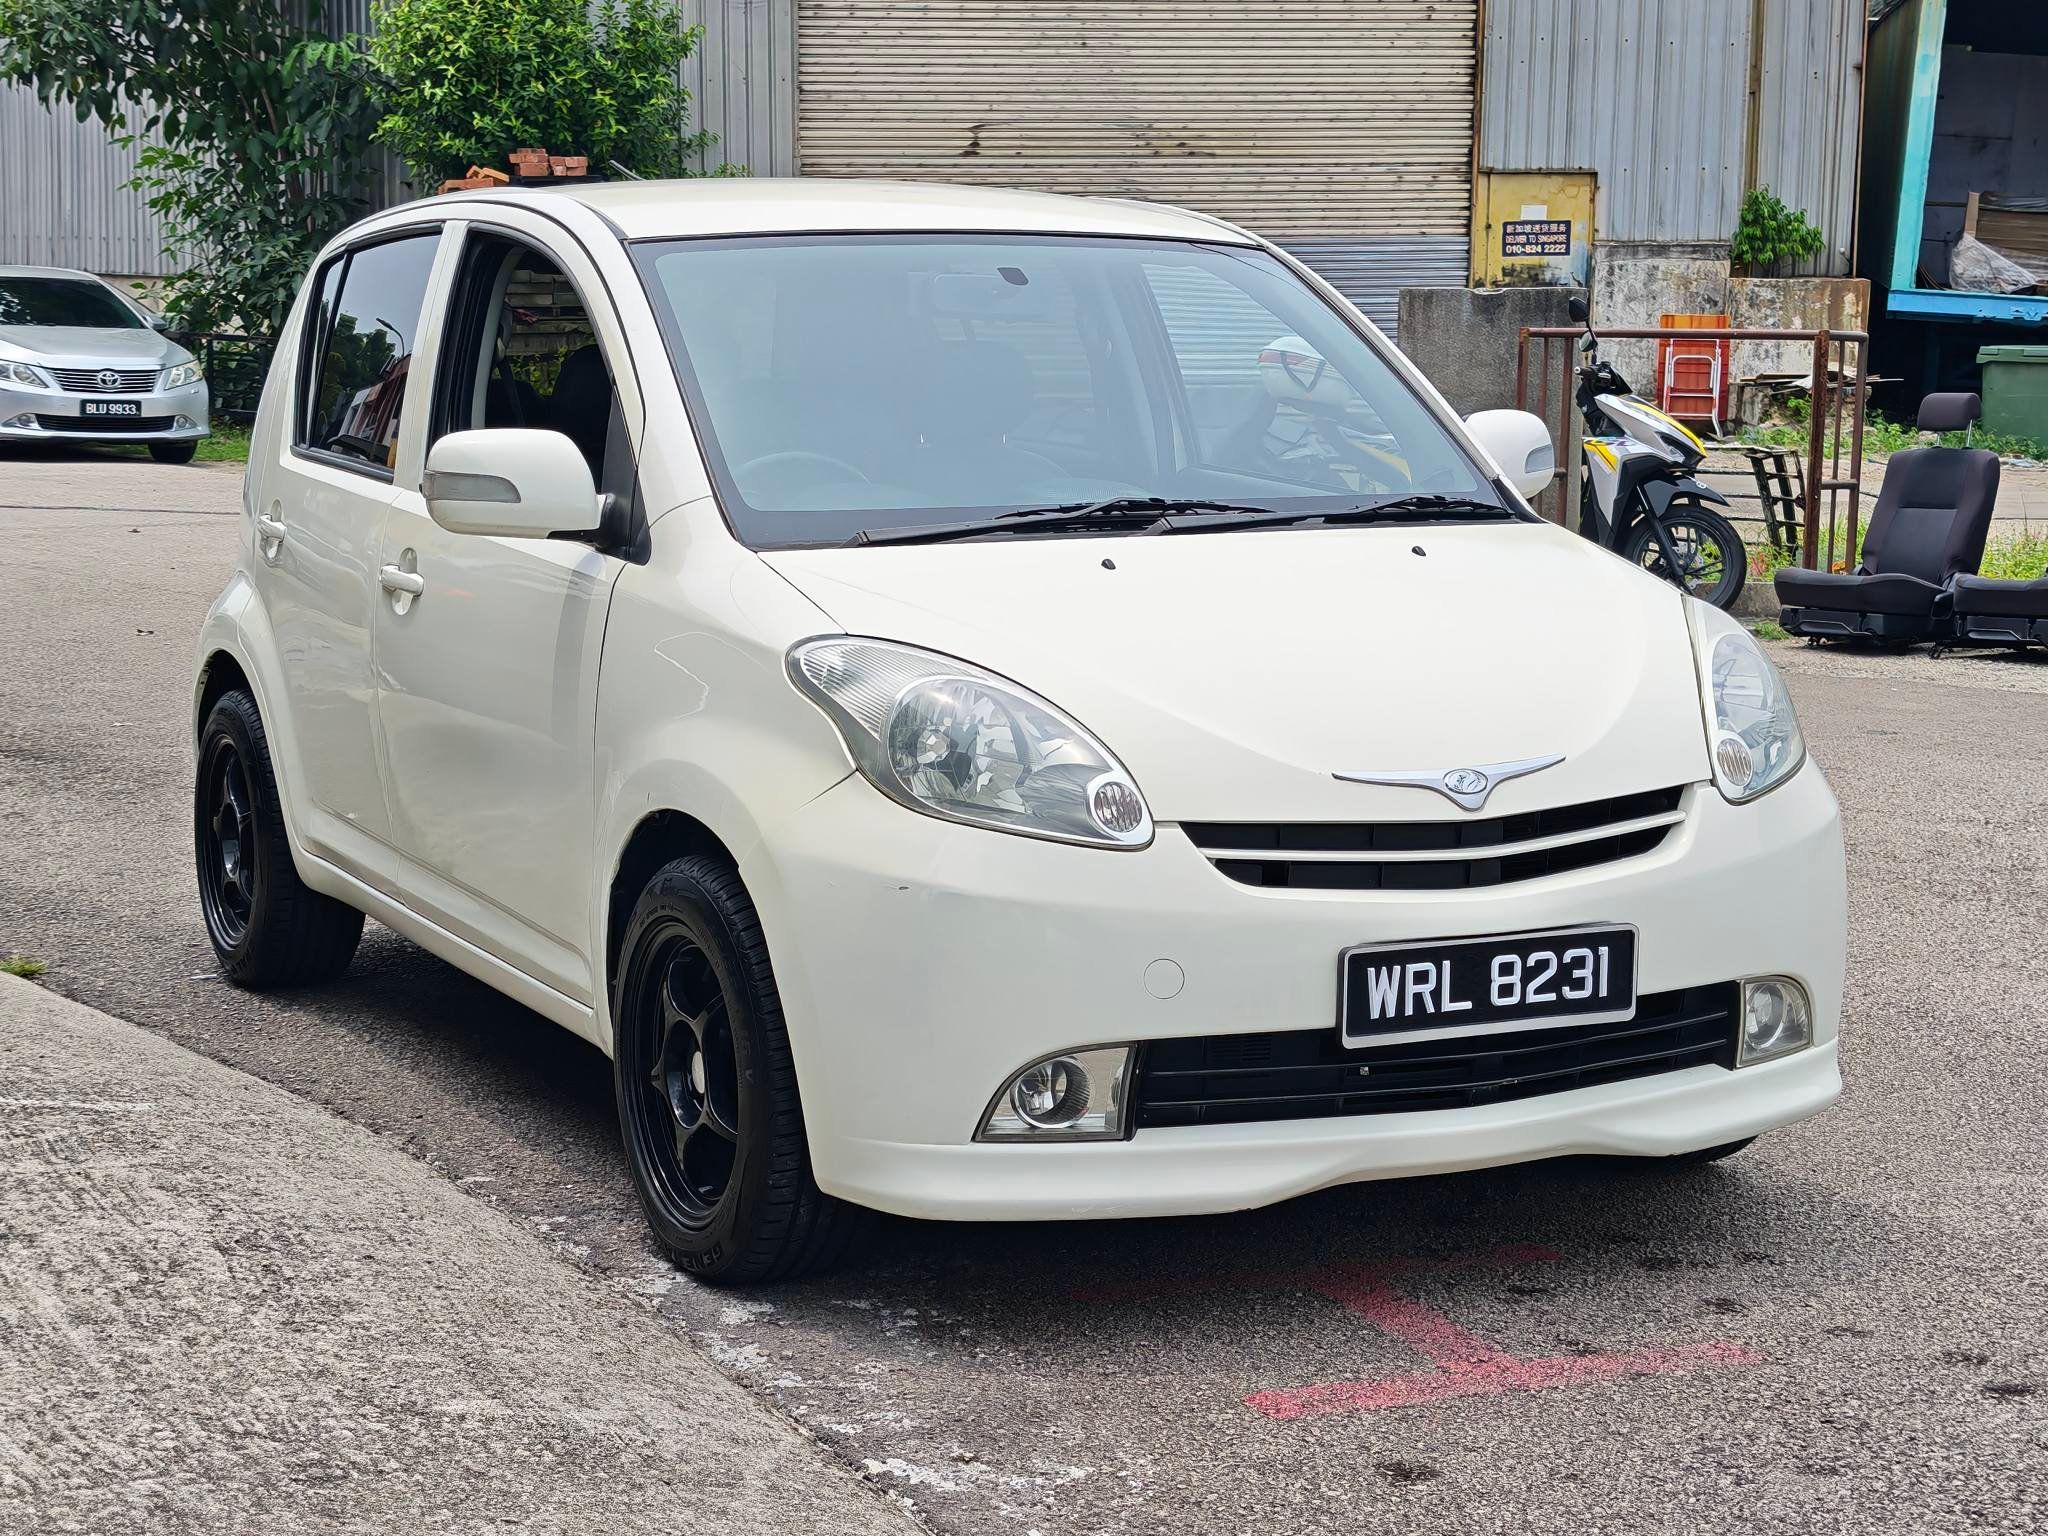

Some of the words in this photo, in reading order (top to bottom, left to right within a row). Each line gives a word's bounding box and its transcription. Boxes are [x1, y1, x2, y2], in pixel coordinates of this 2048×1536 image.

[1505, 235, 1527, 243] DELIVER
[1528, 235, 1536, 243] TO
[1537, 235, 1567, 243] SINGAPORE
[1505, 245, 1542, 253] 010-824
[1543, 244, 1566, 253] 2222
[86, 403, 106, 414] BLU
[109, 403, 136, 414] 9933
[1366, 959, 1473, 1020] WRL
[1490, 946, 1609, 1007] 8231
